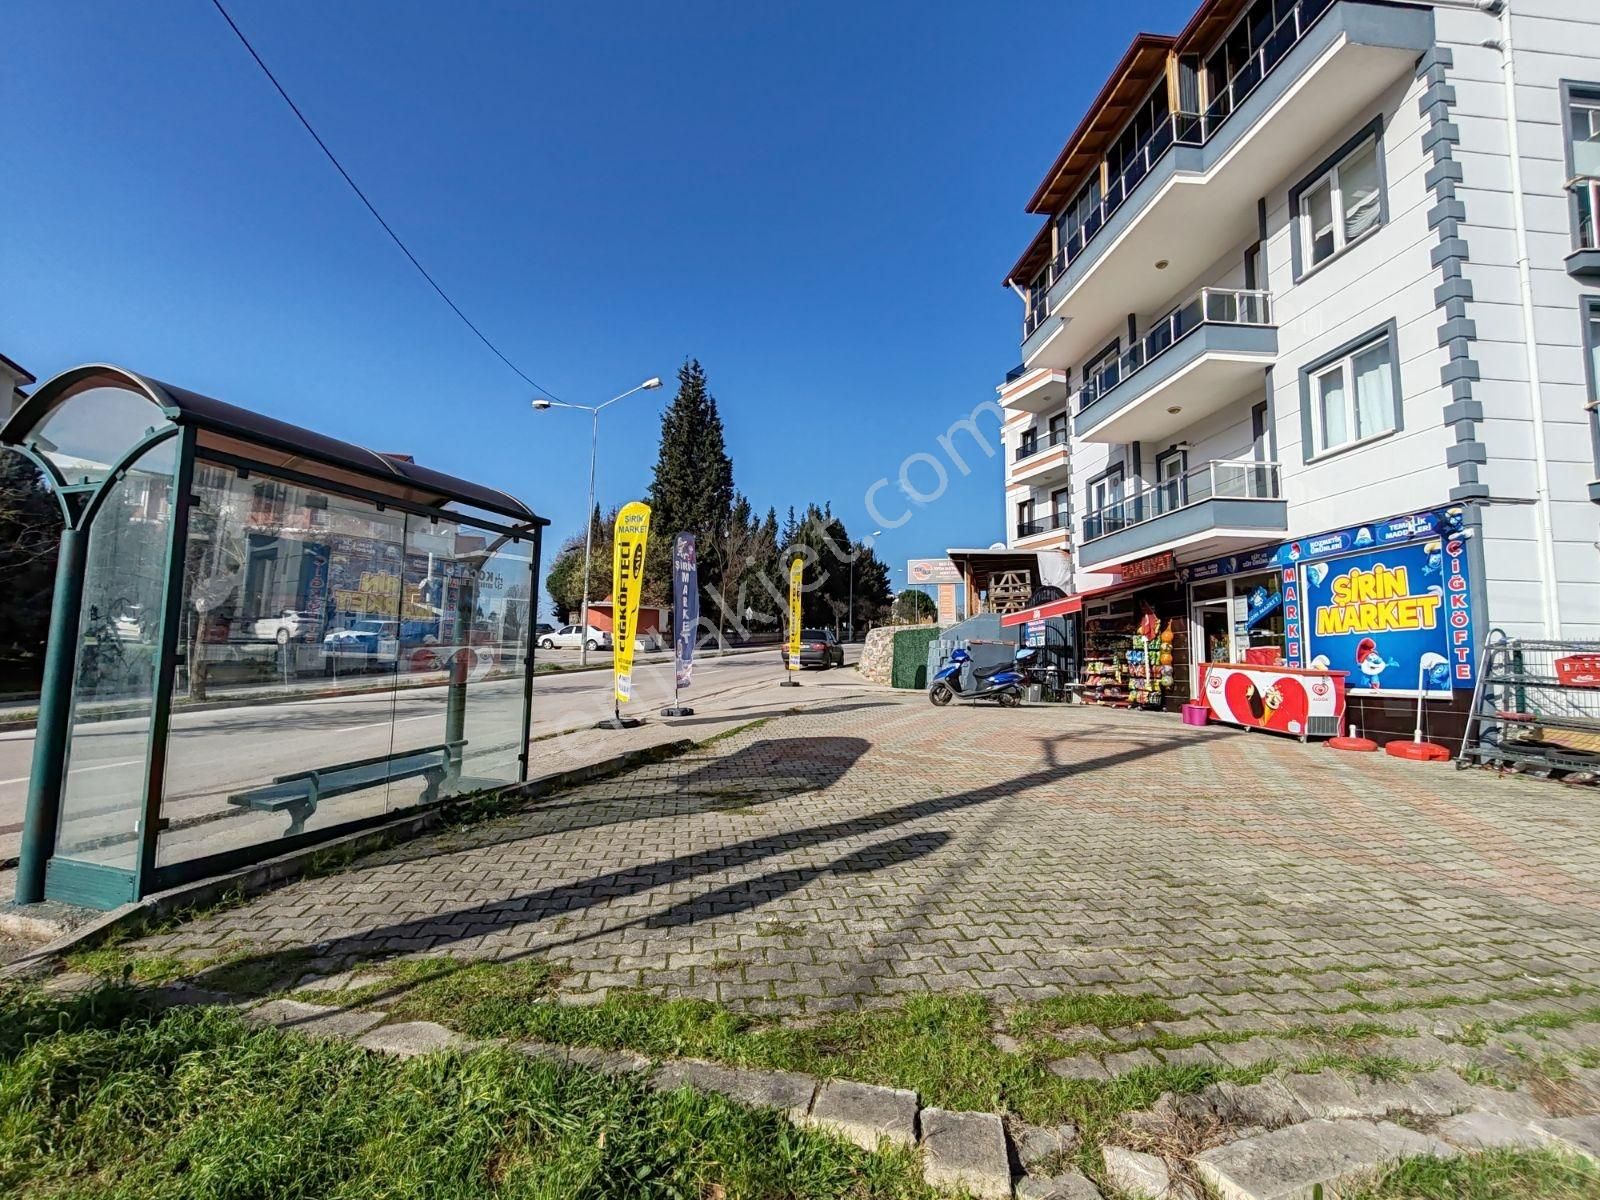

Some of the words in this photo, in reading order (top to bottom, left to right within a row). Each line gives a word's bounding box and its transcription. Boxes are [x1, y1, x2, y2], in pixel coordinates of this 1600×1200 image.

[618, 525, 648, 534] MARKET
[1385, 522, 1432, 539] MADDLERİ
[1331, 563, 1409, 607] ŞİRİN
[681, 571, 692, 645] MARKET
[1315, 594, 1442, 637] MARKET
[1446, 540, 1471, 681] ÇİĞKÖFTE
